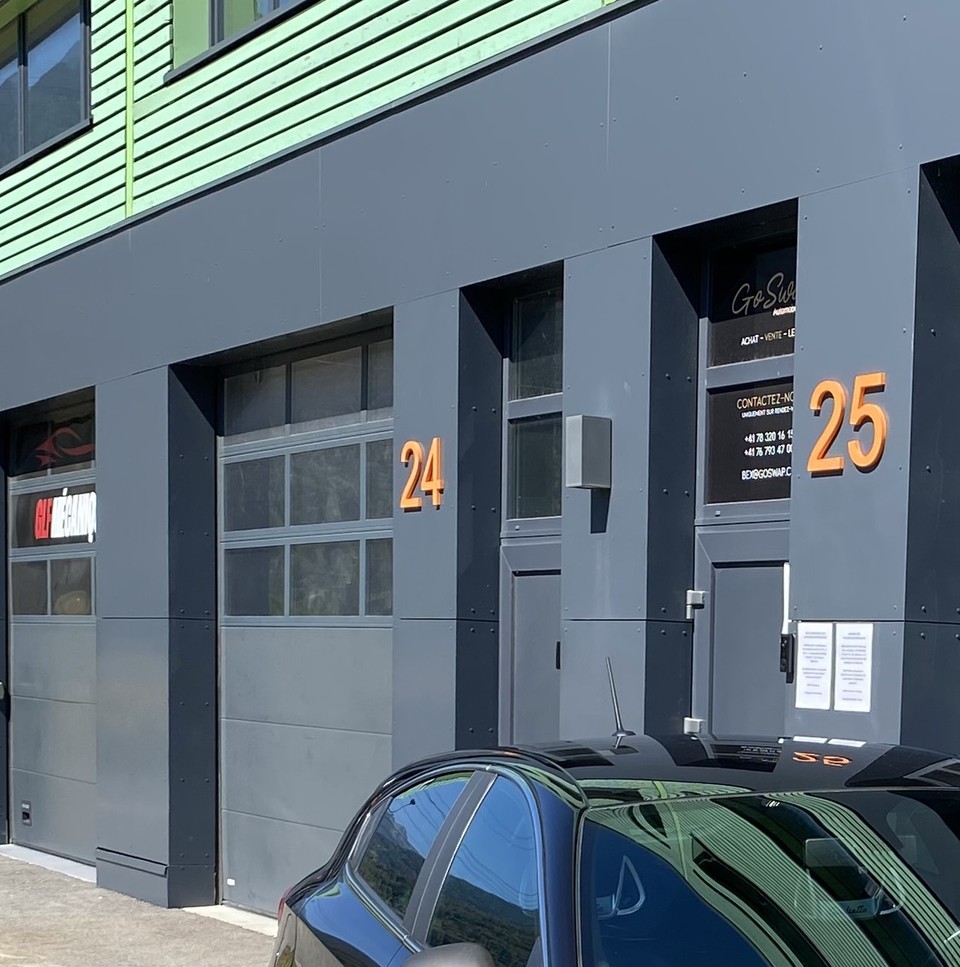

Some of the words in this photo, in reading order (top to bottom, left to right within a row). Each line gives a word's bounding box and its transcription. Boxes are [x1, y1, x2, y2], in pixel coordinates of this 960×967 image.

[740, 334, 759, 346] ACHAT
[764, 331, 782, 341] VENTE
[807, 372, 888, 475] 25
[764, 432, 776, 441] 320
[778, 431, 786, 440] 16
[776, 444, 785, 455] 47
[400, 437, 445, 509] 24
